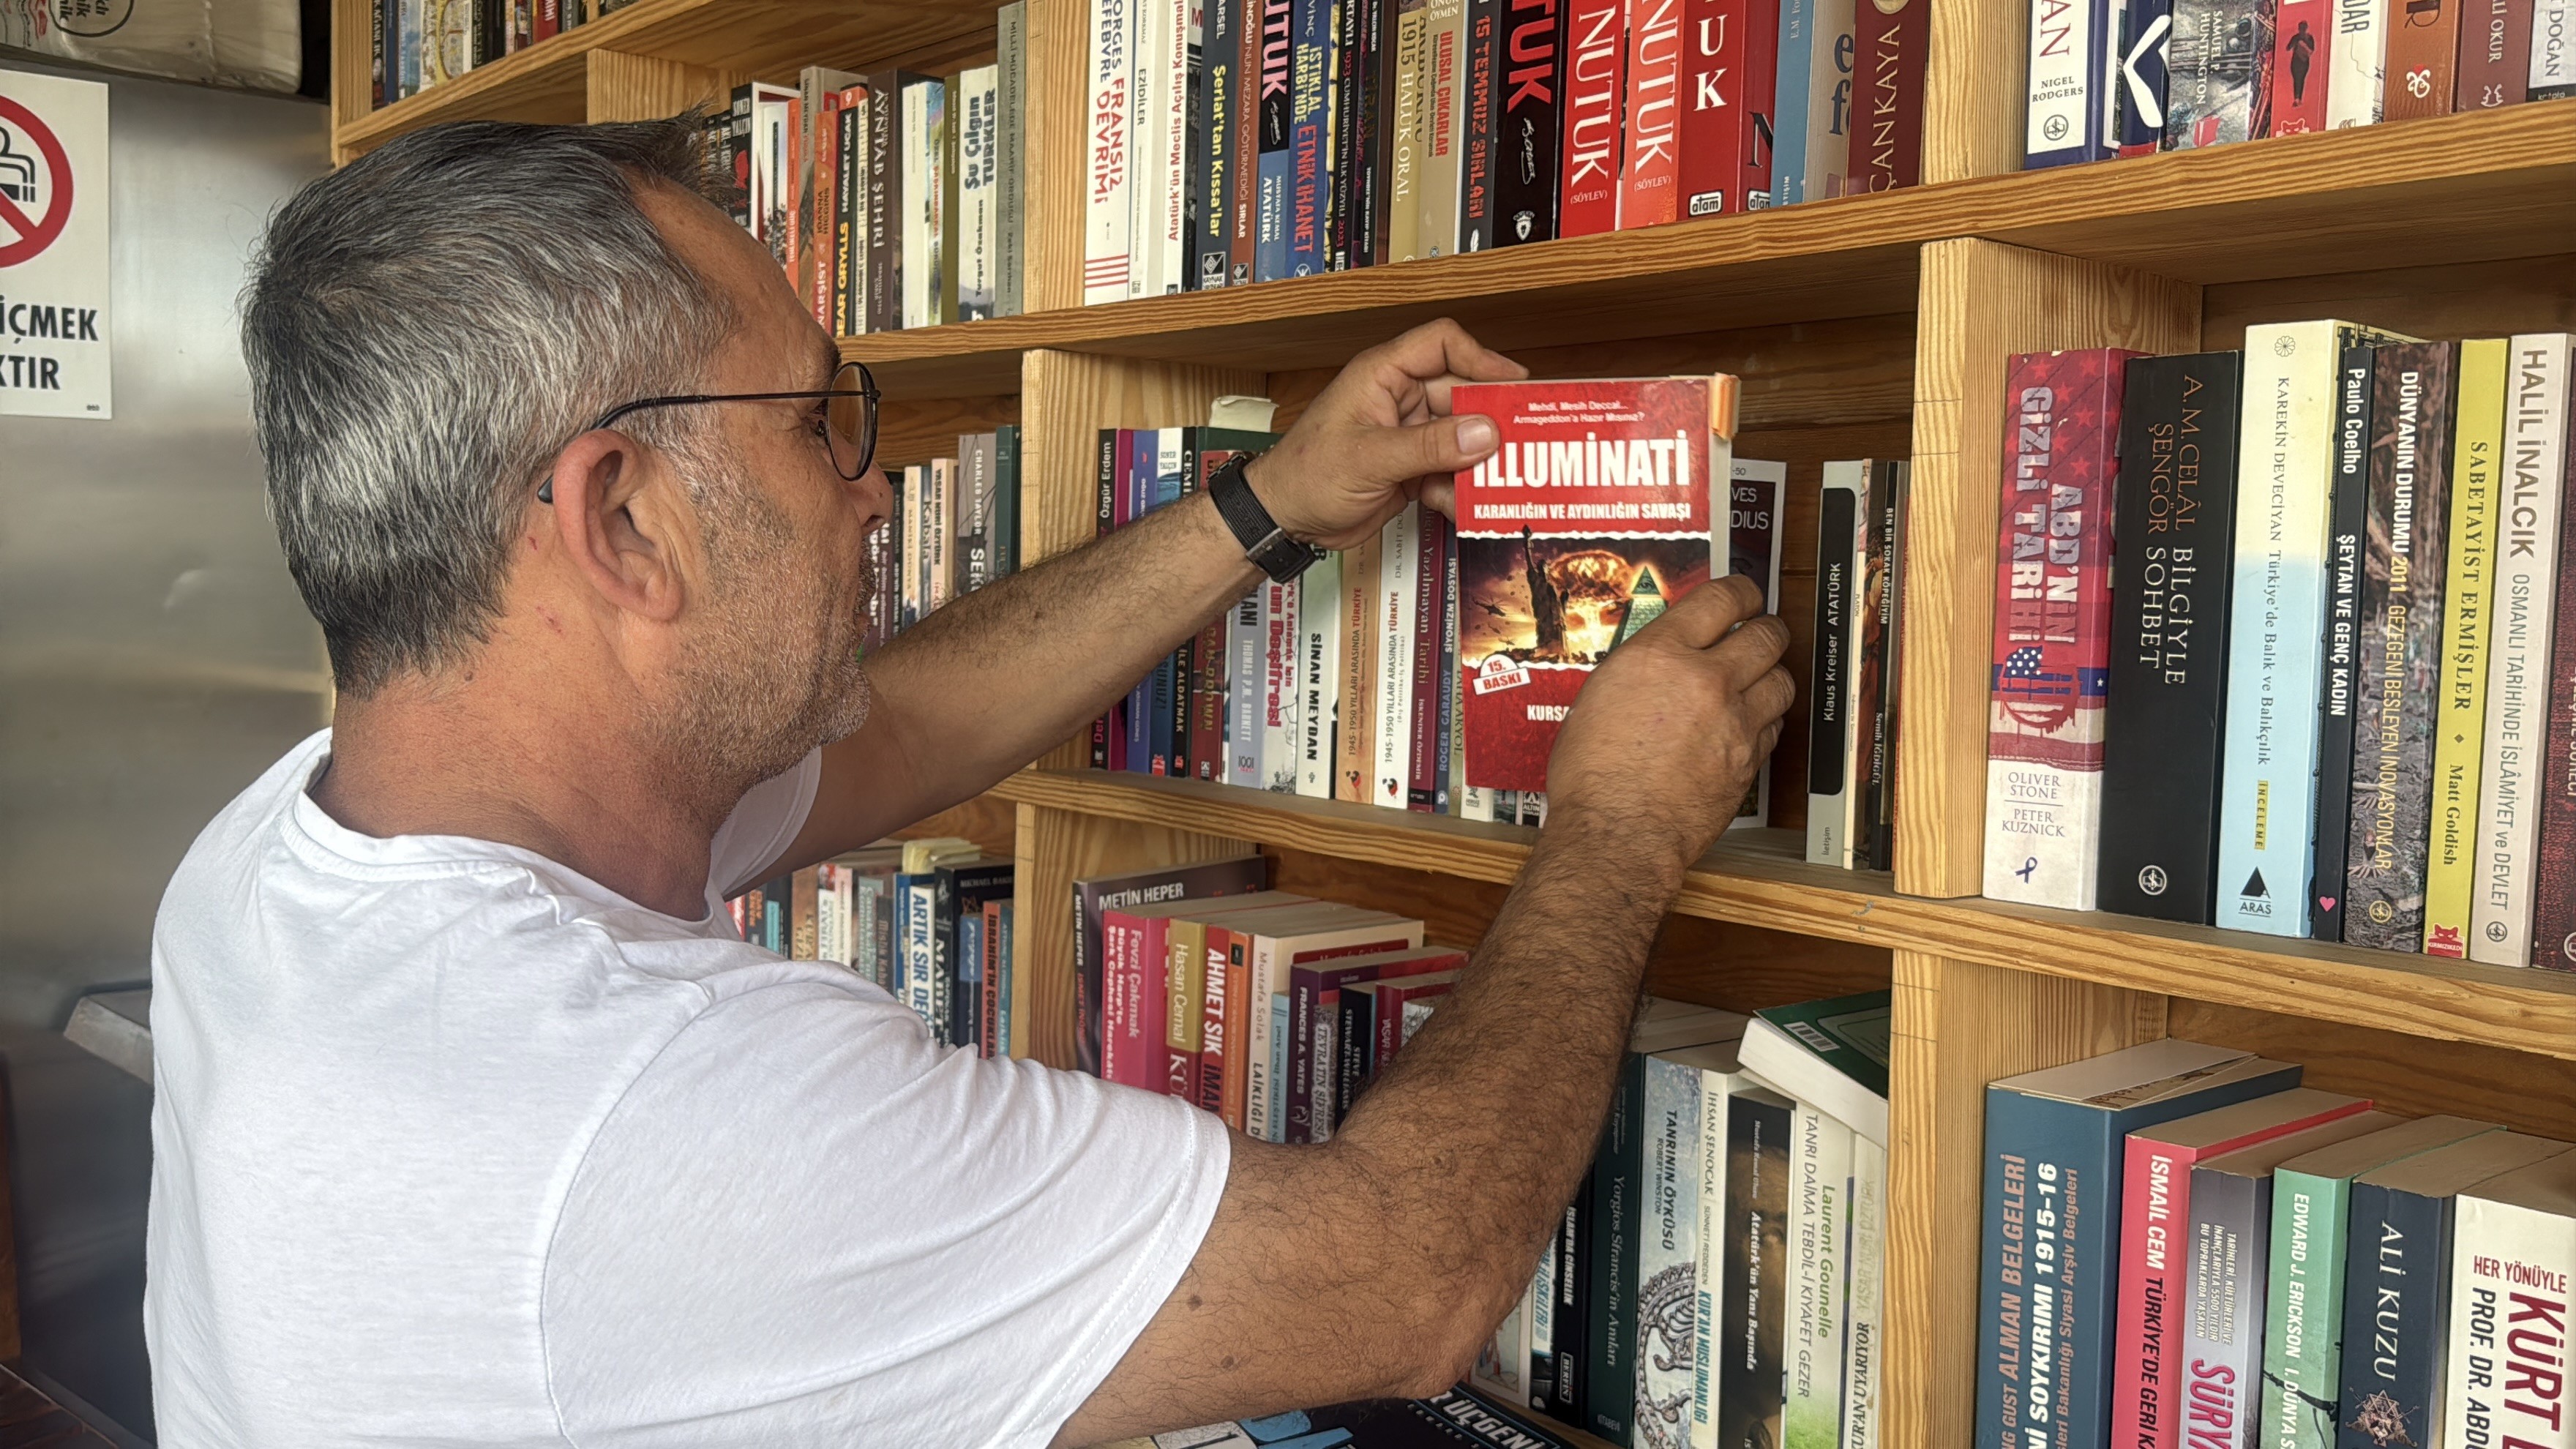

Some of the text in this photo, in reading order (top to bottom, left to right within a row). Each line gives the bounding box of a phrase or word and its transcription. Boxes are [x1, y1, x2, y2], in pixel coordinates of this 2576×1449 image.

[2040, 76, 2075, 89] NIGEL
[2196, 12, 2211, 105] HUNTINGTON
[2210, 10, 2223, 61] SAMUEL
[2488, 19, 2504, 64] OKUR
[2545, 10, 2565, 78] DOĞAN
[1109, 78, 1125, 192] FRANSIZ
[1137, 68, 1147, 127] EZİDİLER
[1172, 72, 1184, 114] Açılış
[1396, 19, 1418, 202] 1915 HALUK ORAL
[1435, 31, 1453, 157] ULUSAL ÇIKARLAR
[1469, 15, 1491, 220] 15 TEMMUZ SIRLARI
[1571, 5, 1617, 188] NUTUK
[1635, 0, 1679, 175] NUTUK
[1869, 23, 1901, 193] ÇANKAYA
[2032, 86, 2084, 103] RODGERS
[964, 96, 982, 190] Şu Çılgın
[1094, 90, 1111, 204] DEVRİMİ
[1169, 119, 1181, 165] Meclis
[1209, 64, 1227, 238] Şeriat'tan Kıssa'lar
[1294, 124, 1317, 254] ETNİK İHANET
[1633, 175, 1671, 192] (SÖYLEV)
[872, 182, 886, 249] ŞEHRİ
[1168, 170, 1180, 242] Atatürk'ün
[1238, 203, 1248, 239] SIRLAR
[1261, 176, 1273, 244] ATATÜRK
[1570, 190, 1608, 206] (SÖYLEV)
[1692, 195, 1719, 214] atam
[838, 222, 850, 291] GRYLLS
[975, 199, 984, 298] Turgut Özakman
[1098, 441, 1112, 519] Özgür Erdem
[1473, 501, 1691, 523] KARANLIĞIN VE AYDINLIĞIN SAVAŞI
[2008, 386, 2053, 643] GİZLİ TARİHİ
[2148, 423, 2175, 536] ŞENGÖR
[1880, 507, 1894, 625] BEN BİR SOKAK KÖPEĞİYİM
[2044, 483, 2083, 643] ABD'NİN
[2256, 376, 2291, 766] KAREKİN DEVECİYAN Türkiye'de Balık ve Balıkçılık
[2329, 367, 2366, 716] Paulo Coelho ŞEYTAN VE GENÇ KADIN
[1242, 639, 1254, 675] THOMAS
[1823, 562, 1841, 722] Klaus Kreiser ATATÜRK
[2140, 546, 2167, 669] SOHBET
[2164, 546, 2197, 685] BİLGİYLE
[2374, 371, 2422, 870] DÜNYANIN DURUMU 2011 GEZEGENİ BESLEYEN İNOVASYONLAR
[2442, 441, 2488, 866] SABETAYİST ERMİŞLER Matt Goldish
[2491, 349, 2550, 911] HALİL İNALCIK OSMANLI TARİHİNDE İSLÂMİYET ve DEVLET
[1306, 632, 1322, 761] SİNAN MEYDAN
[1439, 557, 1457, 772] ROGER GARAUDY SİYONİZM DOSYASI
[1482, 672, 1522, 691] BASKI
[1486, 659, 1507, 673] 15.
[2002, 820, 2066, 838] KUZNICK
[2007, 771, 2062, 788] OLIVER
[2010, 784, 2058, 800] STONE
[2013, 808, 2054, 823] PETER
[912, 893, 929, 984] ARTIK SIR
[1098, 882, 1185, 911] METİN HEPER
[2239, 902, 2272, 915] ARAS
[1172, 943, 1189, 1043] Hasan Cemal
[1205, 947, 1227, 1020] AHMET
[1609, 1175, 1625, 1229] Yorgios
[1661, 1109, 1678, 1251] TANRININ ÖYKÜSÜ
[1748, 1210, 1762, 1287] Atatürk'ün
[1797, 1114, 1819, 1399] TANRI DAİMA TEBDİL-İ KIYAFET GEZER
[1817, 1183, 1836, 1339] Laurent Gounelle
[1998, 1153, 2026, 1381] ALMAN BELGELERİ
[2029, 1162, 2059, 1424] SOYKIRIMI 1915-16
[2056, 1168, 2078, 1417] Bakanlığı Siyasi Arşiv Belgeleri
[2137, 1154, 2174, 1432] İSMAİL CEM TÜRKİYE'DE GERİ
[2195, 1223, 2209, 1339] BU TOPRAKLARDA YAŞAYAN
[2208, 1224, 2225, 1342] İNANÇLARIYLA 5500 YILDIR
[2223, 1232, 2236, 1284] TARİHLERİ,
[2474, 1254, 2568, 1295] HER YÖNÜYLE
[2280, 1193, 2310, 1435] EDWARD ERICKSON DÜNYA
[2373, 1220, 2407, 1382] ALİ KUZU
[2466, 1287, 2497, 1392] PROF. DR.
[1853, 1322, 1870, 1401] UYARIYOR
[2503, 1291, 2567, 1433] KÜRT
